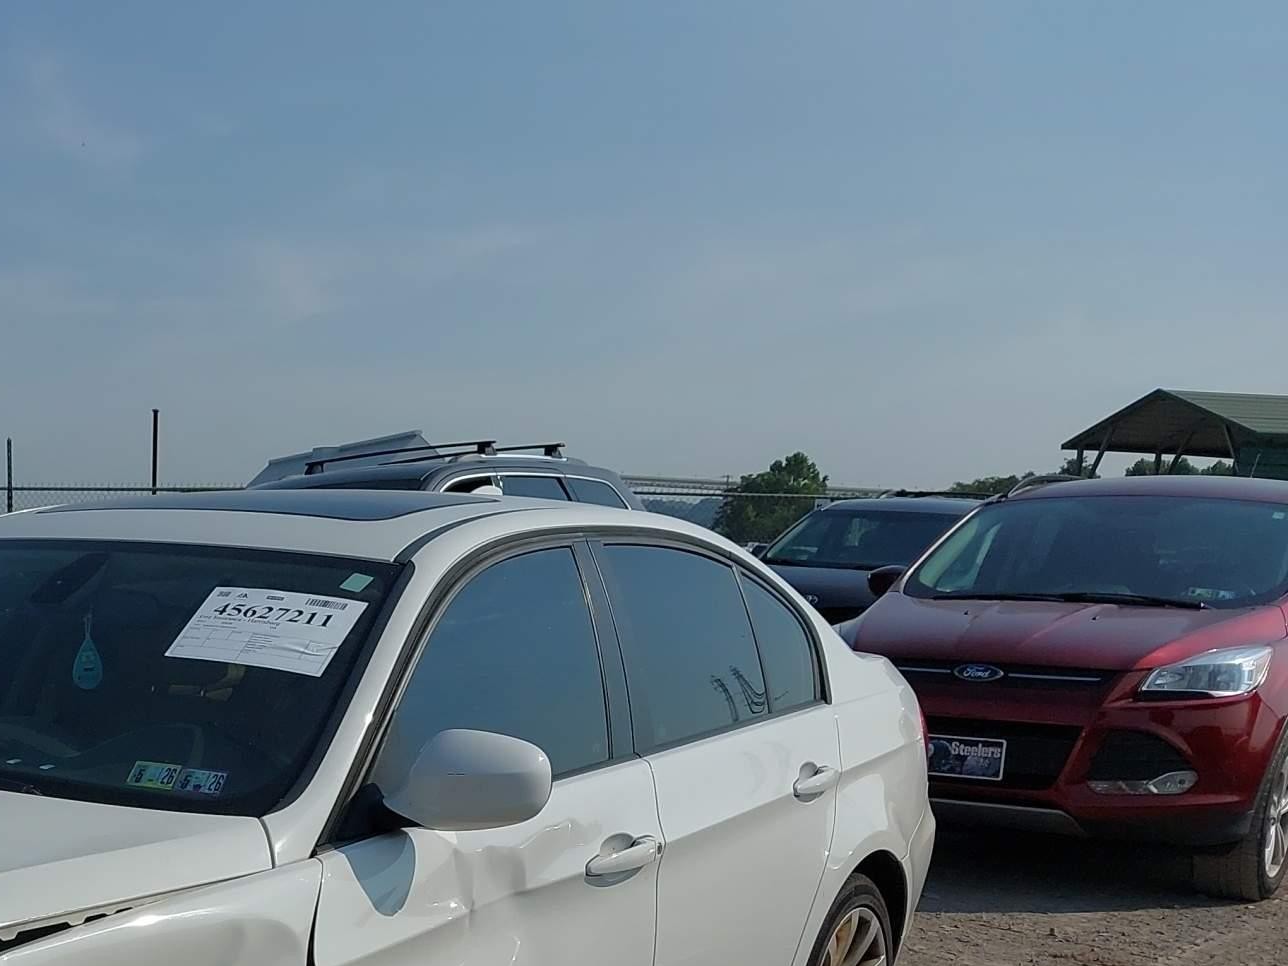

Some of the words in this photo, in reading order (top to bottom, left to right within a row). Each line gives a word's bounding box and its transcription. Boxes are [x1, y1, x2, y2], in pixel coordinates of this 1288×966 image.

[213, 602, 334, 628] 45627211
[963, 667, 991, 678] Ford
[952, 741, 1001, 758] Steelers
[160, 767, 178, 785] 26
[208, 774, 225, 792] 26
